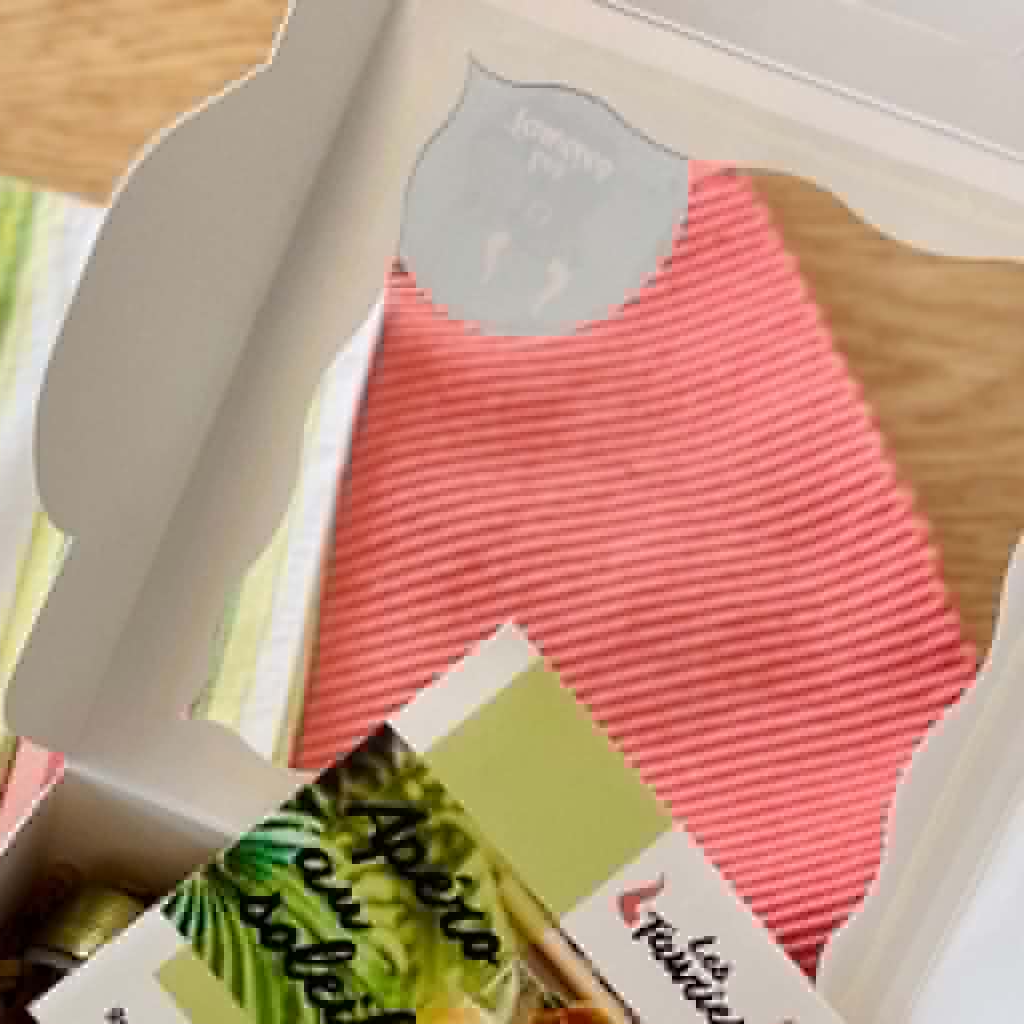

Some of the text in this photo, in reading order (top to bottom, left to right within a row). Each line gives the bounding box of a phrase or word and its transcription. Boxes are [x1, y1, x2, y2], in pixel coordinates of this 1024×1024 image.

[298, 848, 371, 930] au
[342, 804, 502, 966] Apéro
[687, 935, 729, 985] Les
